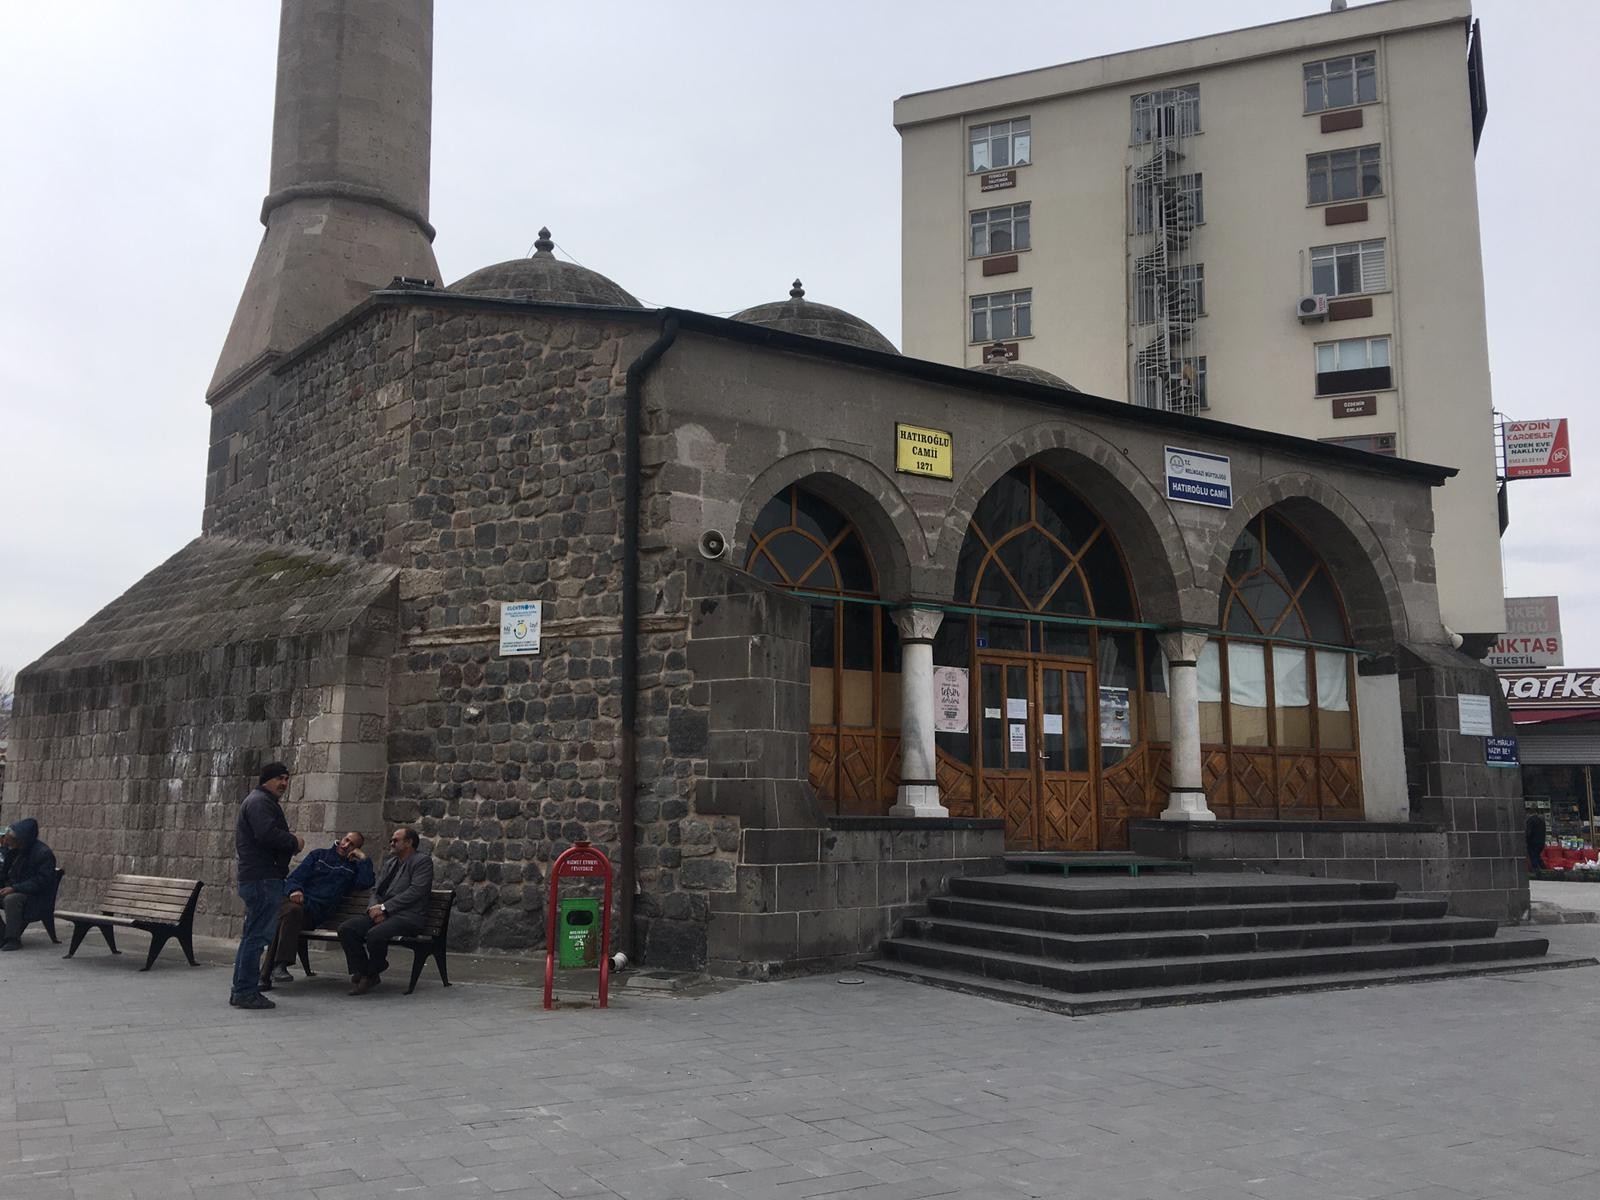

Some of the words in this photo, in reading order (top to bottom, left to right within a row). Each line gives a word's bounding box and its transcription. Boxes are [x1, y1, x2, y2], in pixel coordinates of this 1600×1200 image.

[1509, 422, 1550, 431] AYDIN
[900, 430, 950, 448] HATIROĞLU
[912, 446, 938, 459] CAMİİ
[916, 461, 933, 471] 1271
[1172, 482, 1209, 496] HATIROĞLU
[1209, 488, 1228, 499] CAMİİ
[1488, 638, 1558, 655] NKTAŞ
[1489, 654, 1536, 665] TEKSTİL
